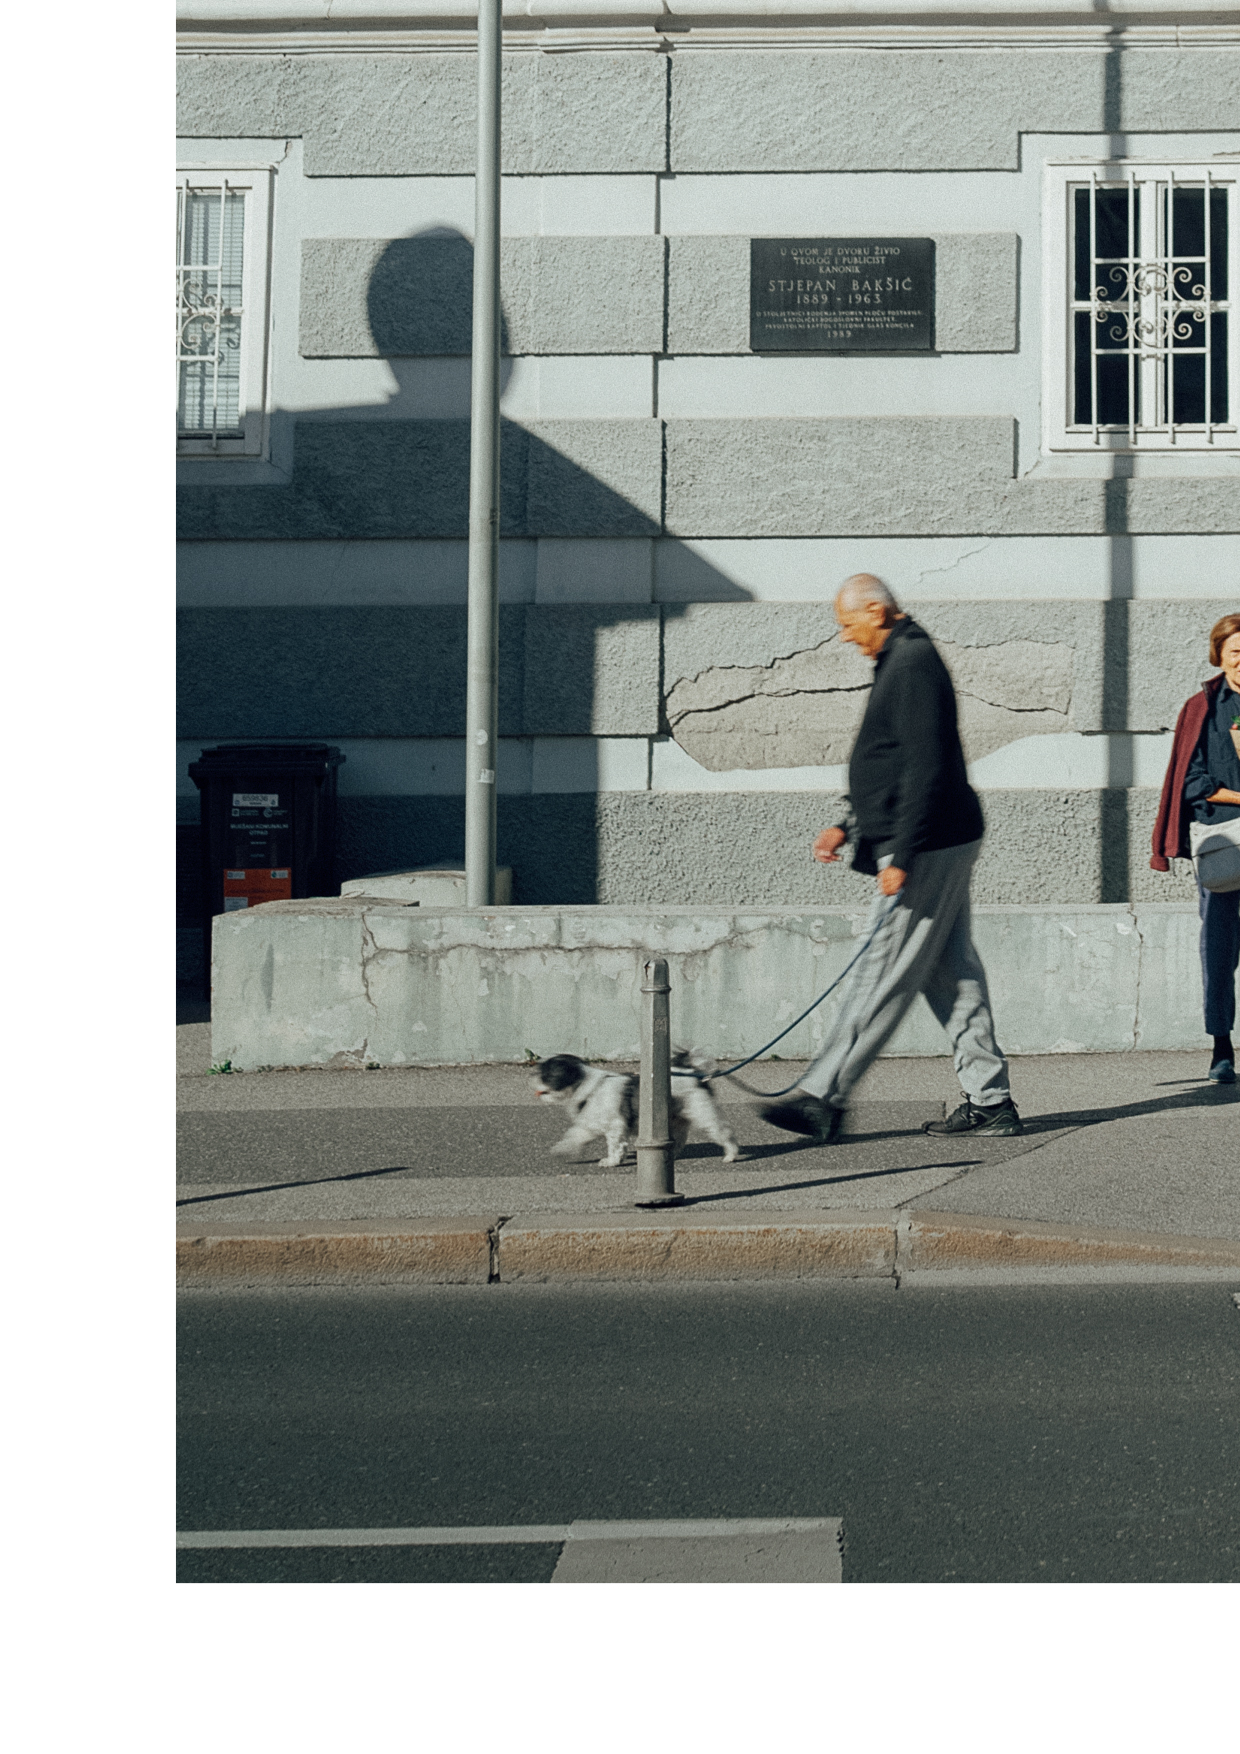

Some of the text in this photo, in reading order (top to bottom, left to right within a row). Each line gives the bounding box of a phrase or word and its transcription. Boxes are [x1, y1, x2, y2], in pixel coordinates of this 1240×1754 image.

[780, 248, 787, 256] U
[823, 248, 832, 256] JE
[837, 247, 870, 256] DVORU
[874, 246, 901, 255] ŽIVIO
[793, 256, 830, 265] TEOLOG
[842, 256, 886, 264] PUBLICIST
[819, 265, 861, 274] KANONIK
[768, 277, 913, 292] STJEPAN BAKŠIĆ
[796, 293, 828, 305] 1889
[848, 293, 882, 304] 1963
[826, 329, 852, 338] 1989
